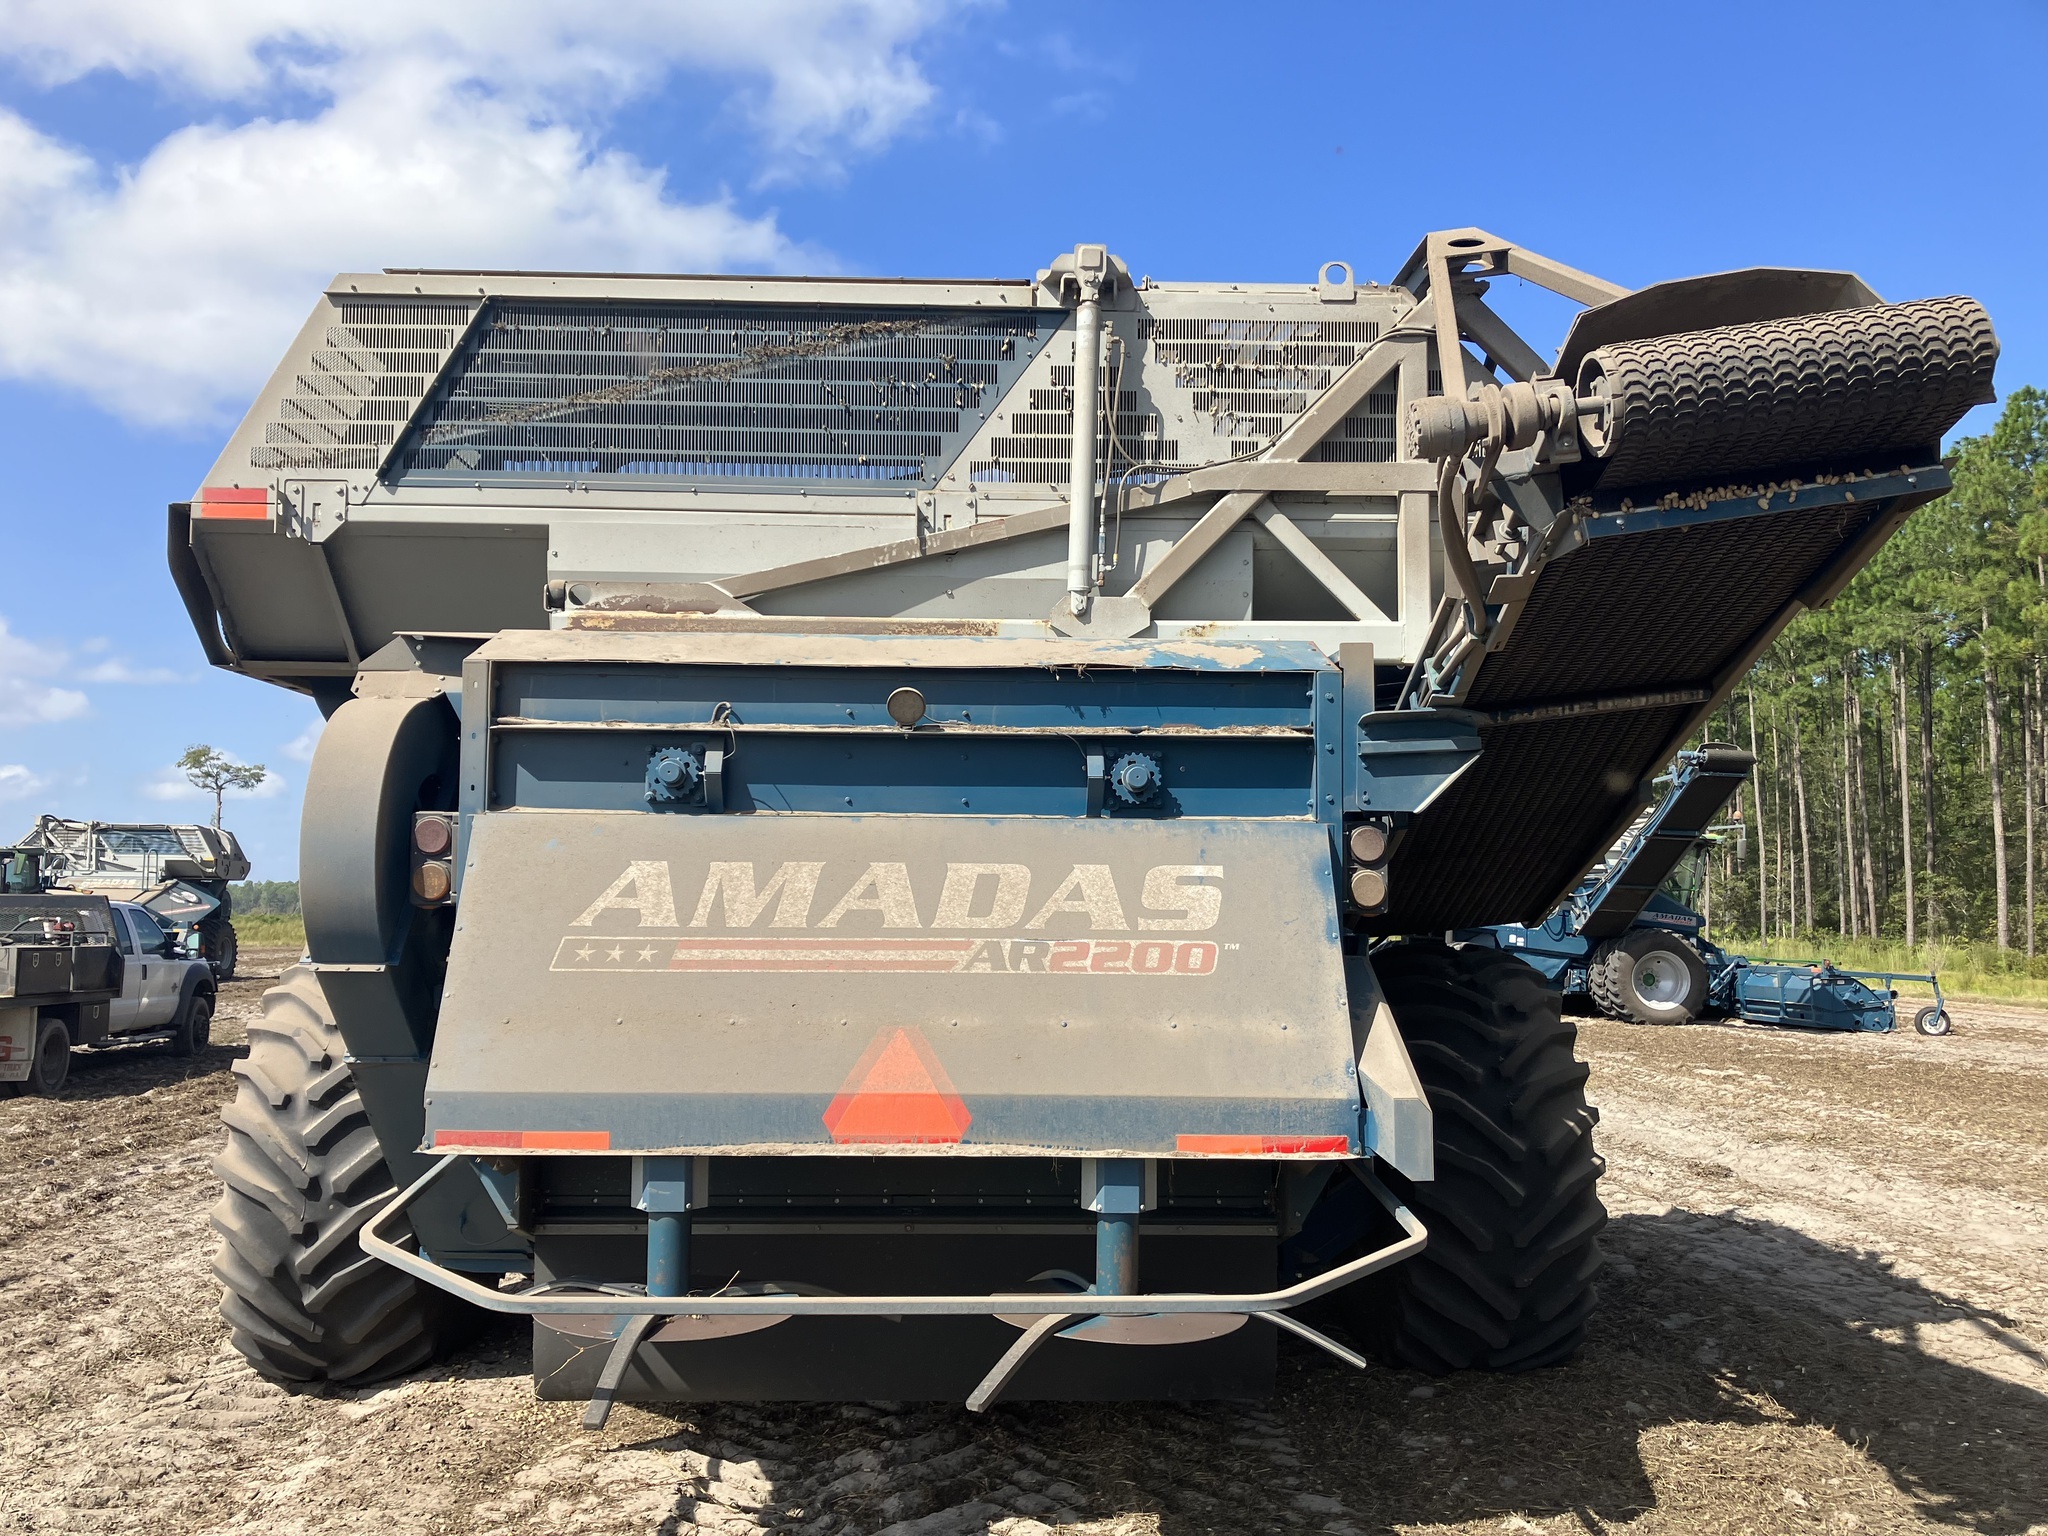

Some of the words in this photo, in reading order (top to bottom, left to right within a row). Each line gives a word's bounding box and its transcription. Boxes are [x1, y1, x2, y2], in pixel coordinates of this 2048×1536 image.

[567, 860, 1225, 931] AMADAS
[1653, 913, 1692, 921] AMADAS
[961, 940, 1218, 974] AR2200
